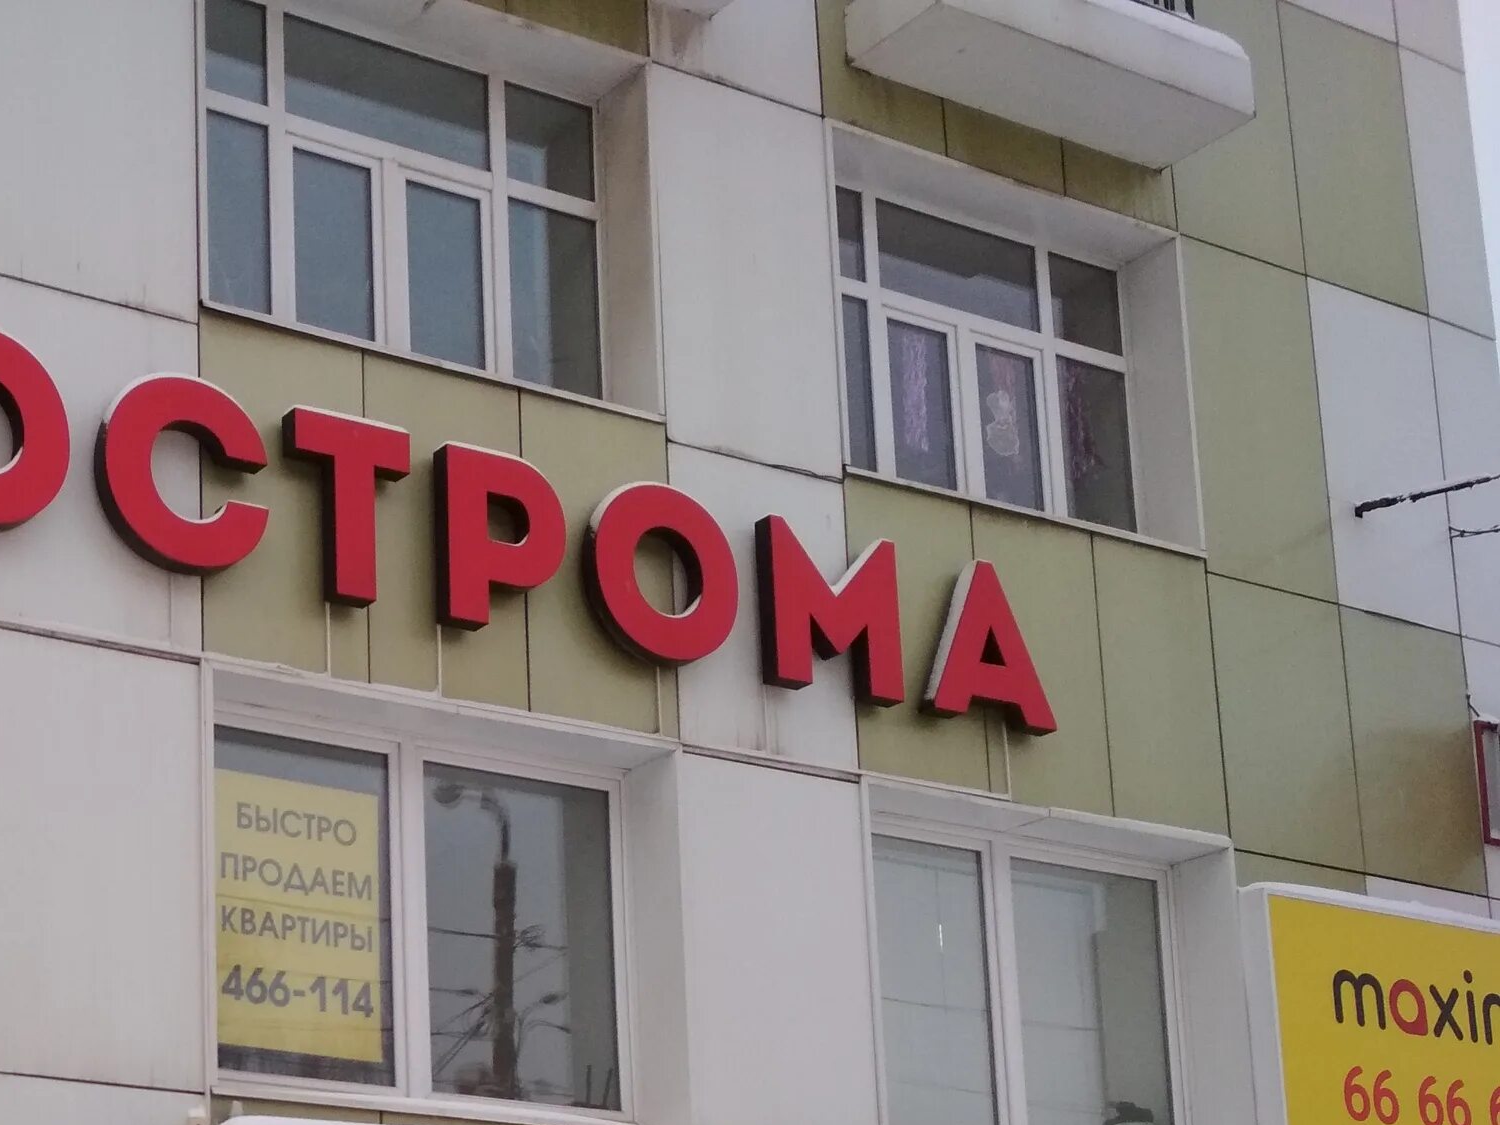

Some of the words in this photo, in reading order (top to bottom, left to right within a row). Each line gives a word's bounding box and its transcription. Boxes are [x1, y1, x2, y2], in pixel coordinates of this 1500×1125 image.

[236, 802, 357, 846] БЫСТРО
[220, 852, 372, 900] ПРОДАЕМ
[221, 905, 373, 953] КВАРТИРЫ
[221, 964, 374, 1018] 466-114
[1344, 1066, 1399, 1125] 66
